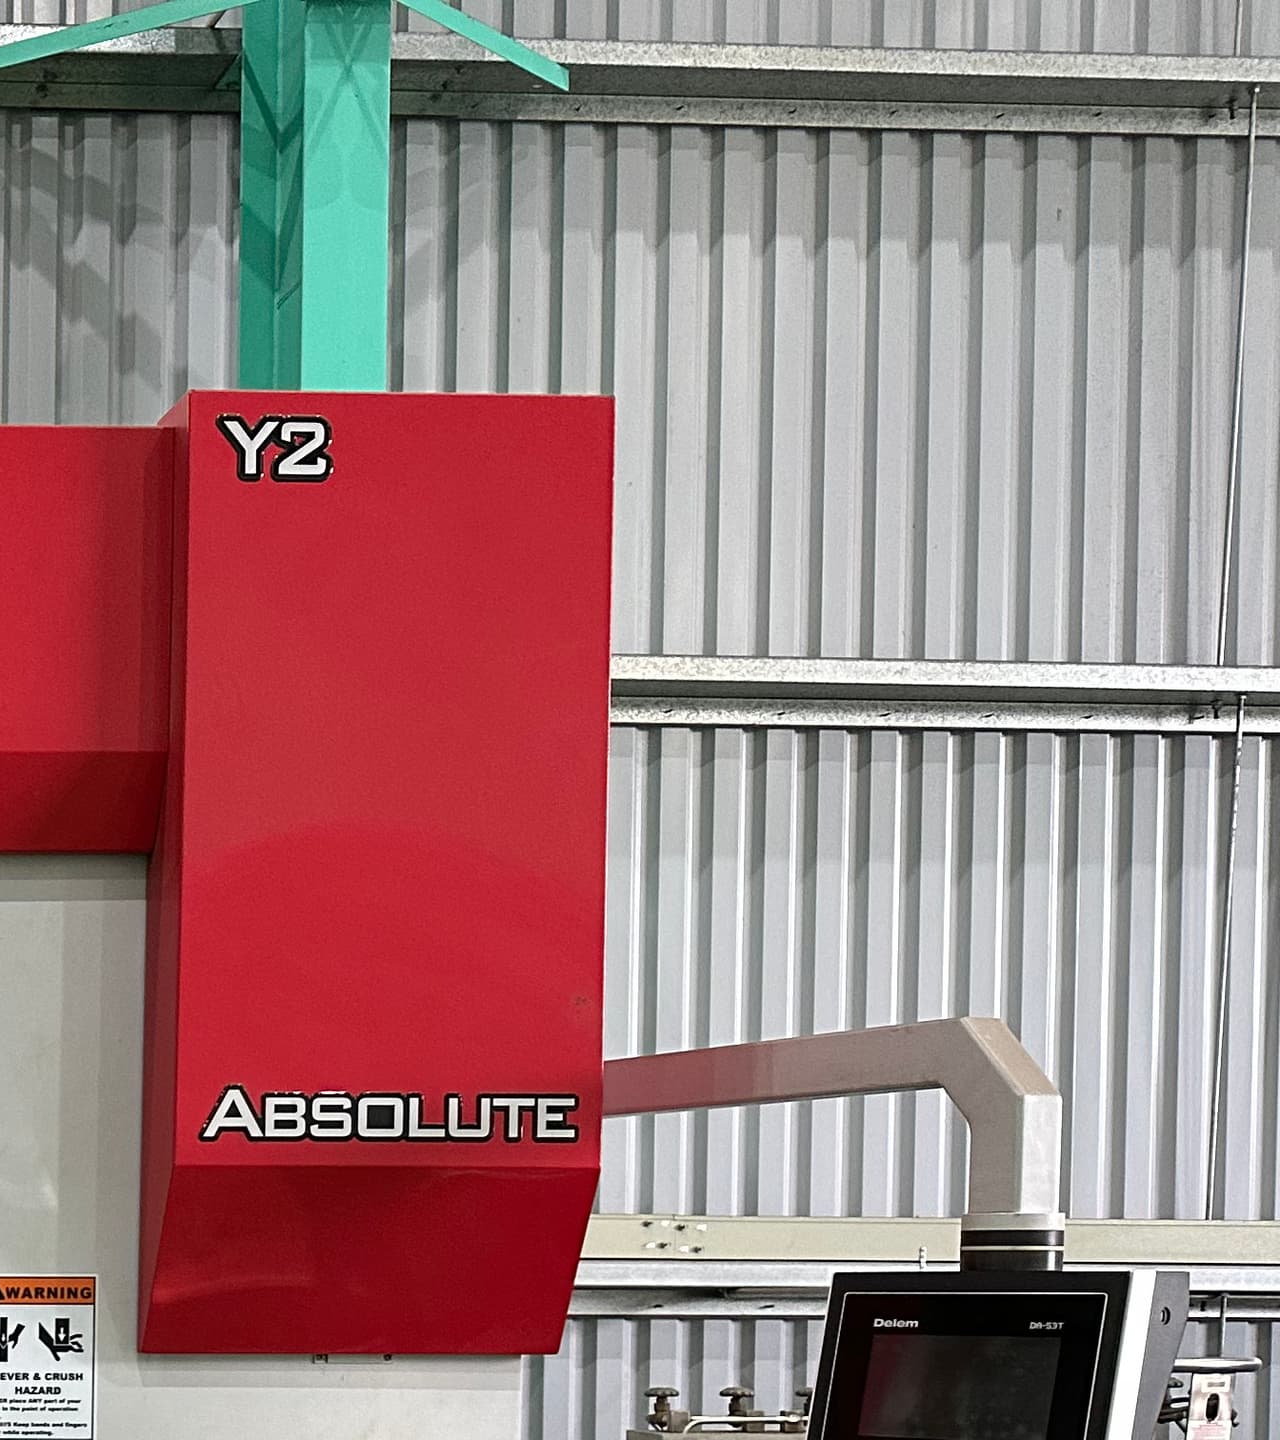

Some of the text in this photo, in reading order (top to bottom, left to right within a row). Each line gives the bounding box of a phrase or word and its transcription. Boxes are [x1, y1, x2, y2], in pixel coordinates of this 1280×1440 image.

[216, 413, 334, 482] Y2
[198, 1084, 580, 1145] ABSOLUTE
[5, 1287, 92, 1299] WARNING
[872, 1317, 919, 1330] Delem
[32, 1372, 41, 1381] &
[44, 1373, 84, 1381] CRUSH
[14, 1386, 62, 1395] HAZARD
